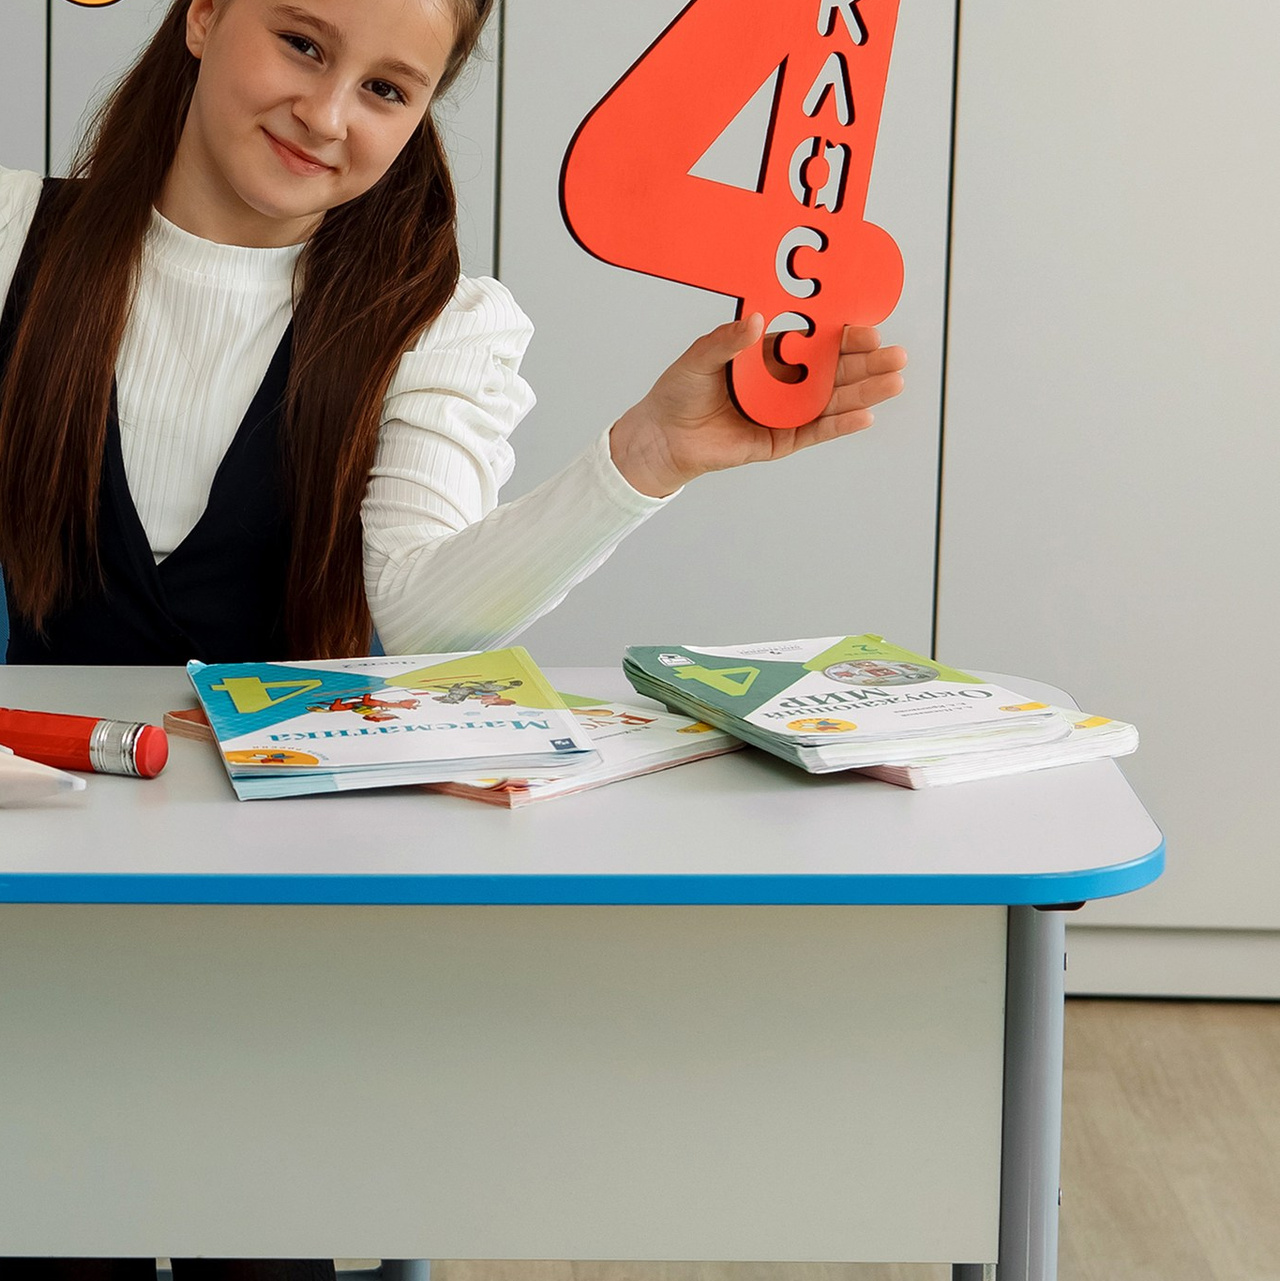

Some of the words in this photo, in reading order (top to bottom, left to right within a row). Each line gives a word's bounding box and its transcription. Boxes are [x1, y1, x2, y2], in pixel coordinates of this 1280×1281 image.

[211, 676, 323, 714] 4
[672, 663, 762, 697] 4
[762, 688, 994, 720] Окружающий
[267, 719, 552, 743] Математика
